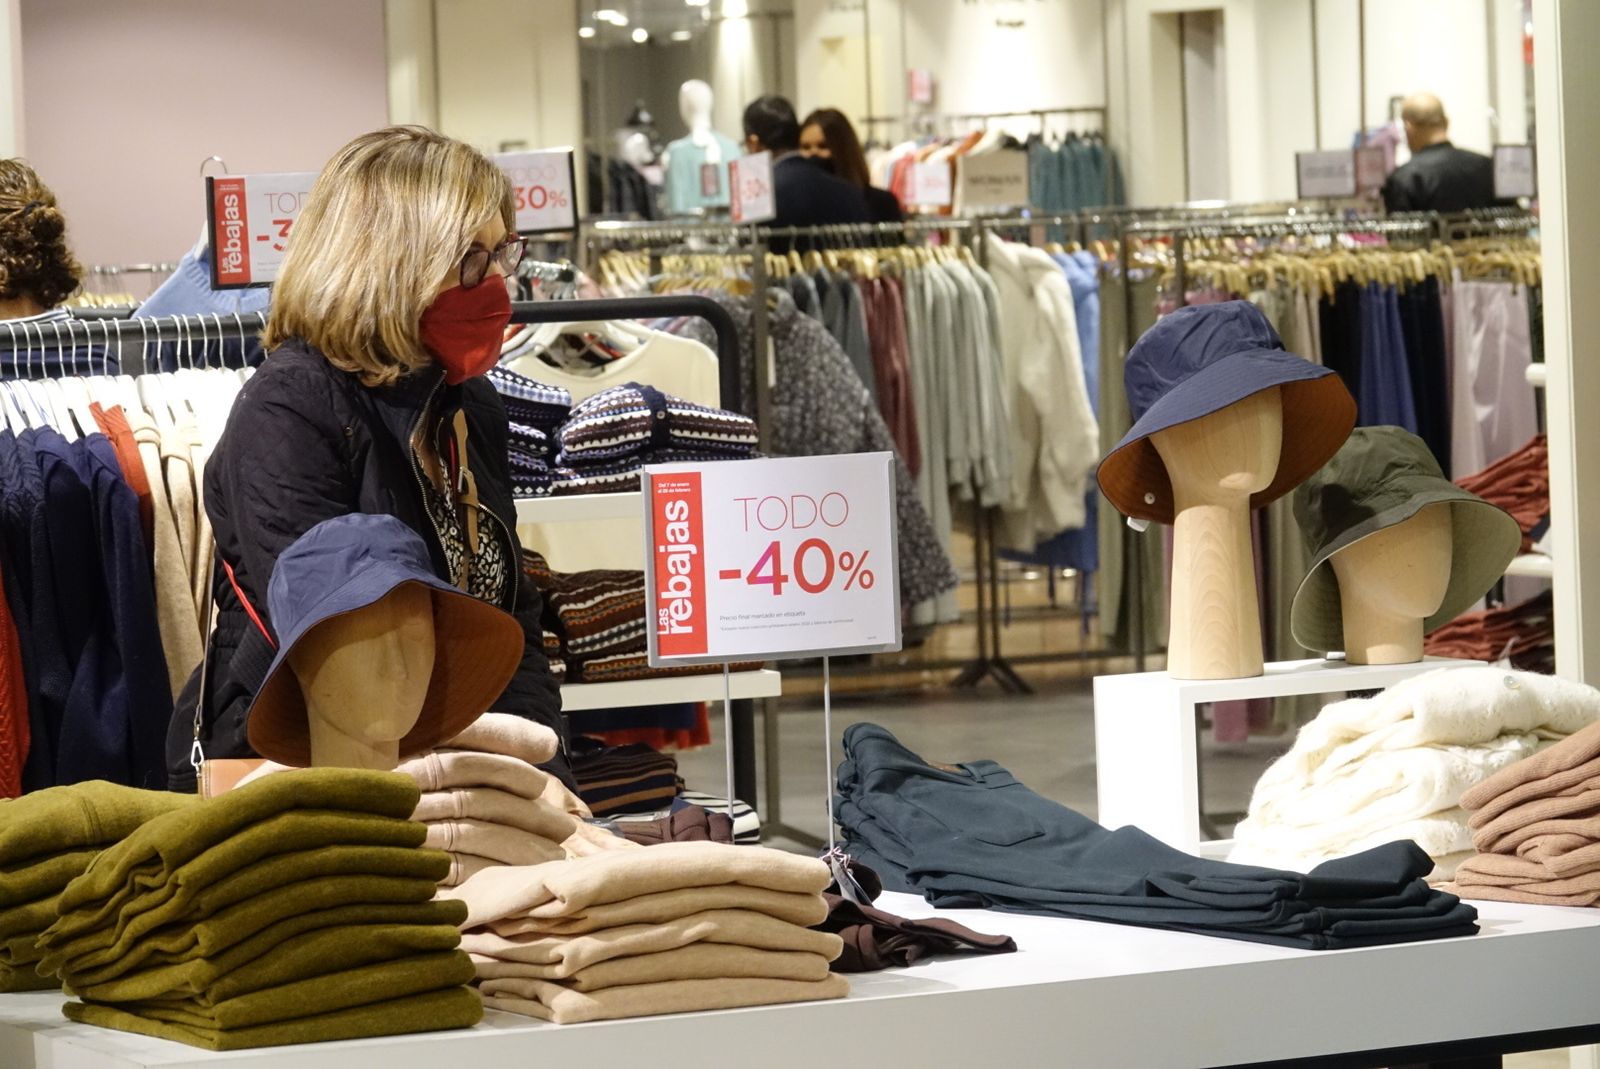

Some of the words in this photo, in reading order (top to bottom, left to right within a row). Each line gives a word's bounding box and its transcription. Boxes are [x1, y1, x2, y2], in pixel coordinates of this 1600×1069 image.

[221, 194, 244, 273] rebajas
[256, 219, 293, 252] -3
[733, 492, 849, 532] TODO
[659, 499, 698, 635] rebajas
[719, 537, 875, 596] -40%
[657, 607, 670, 635] Las
